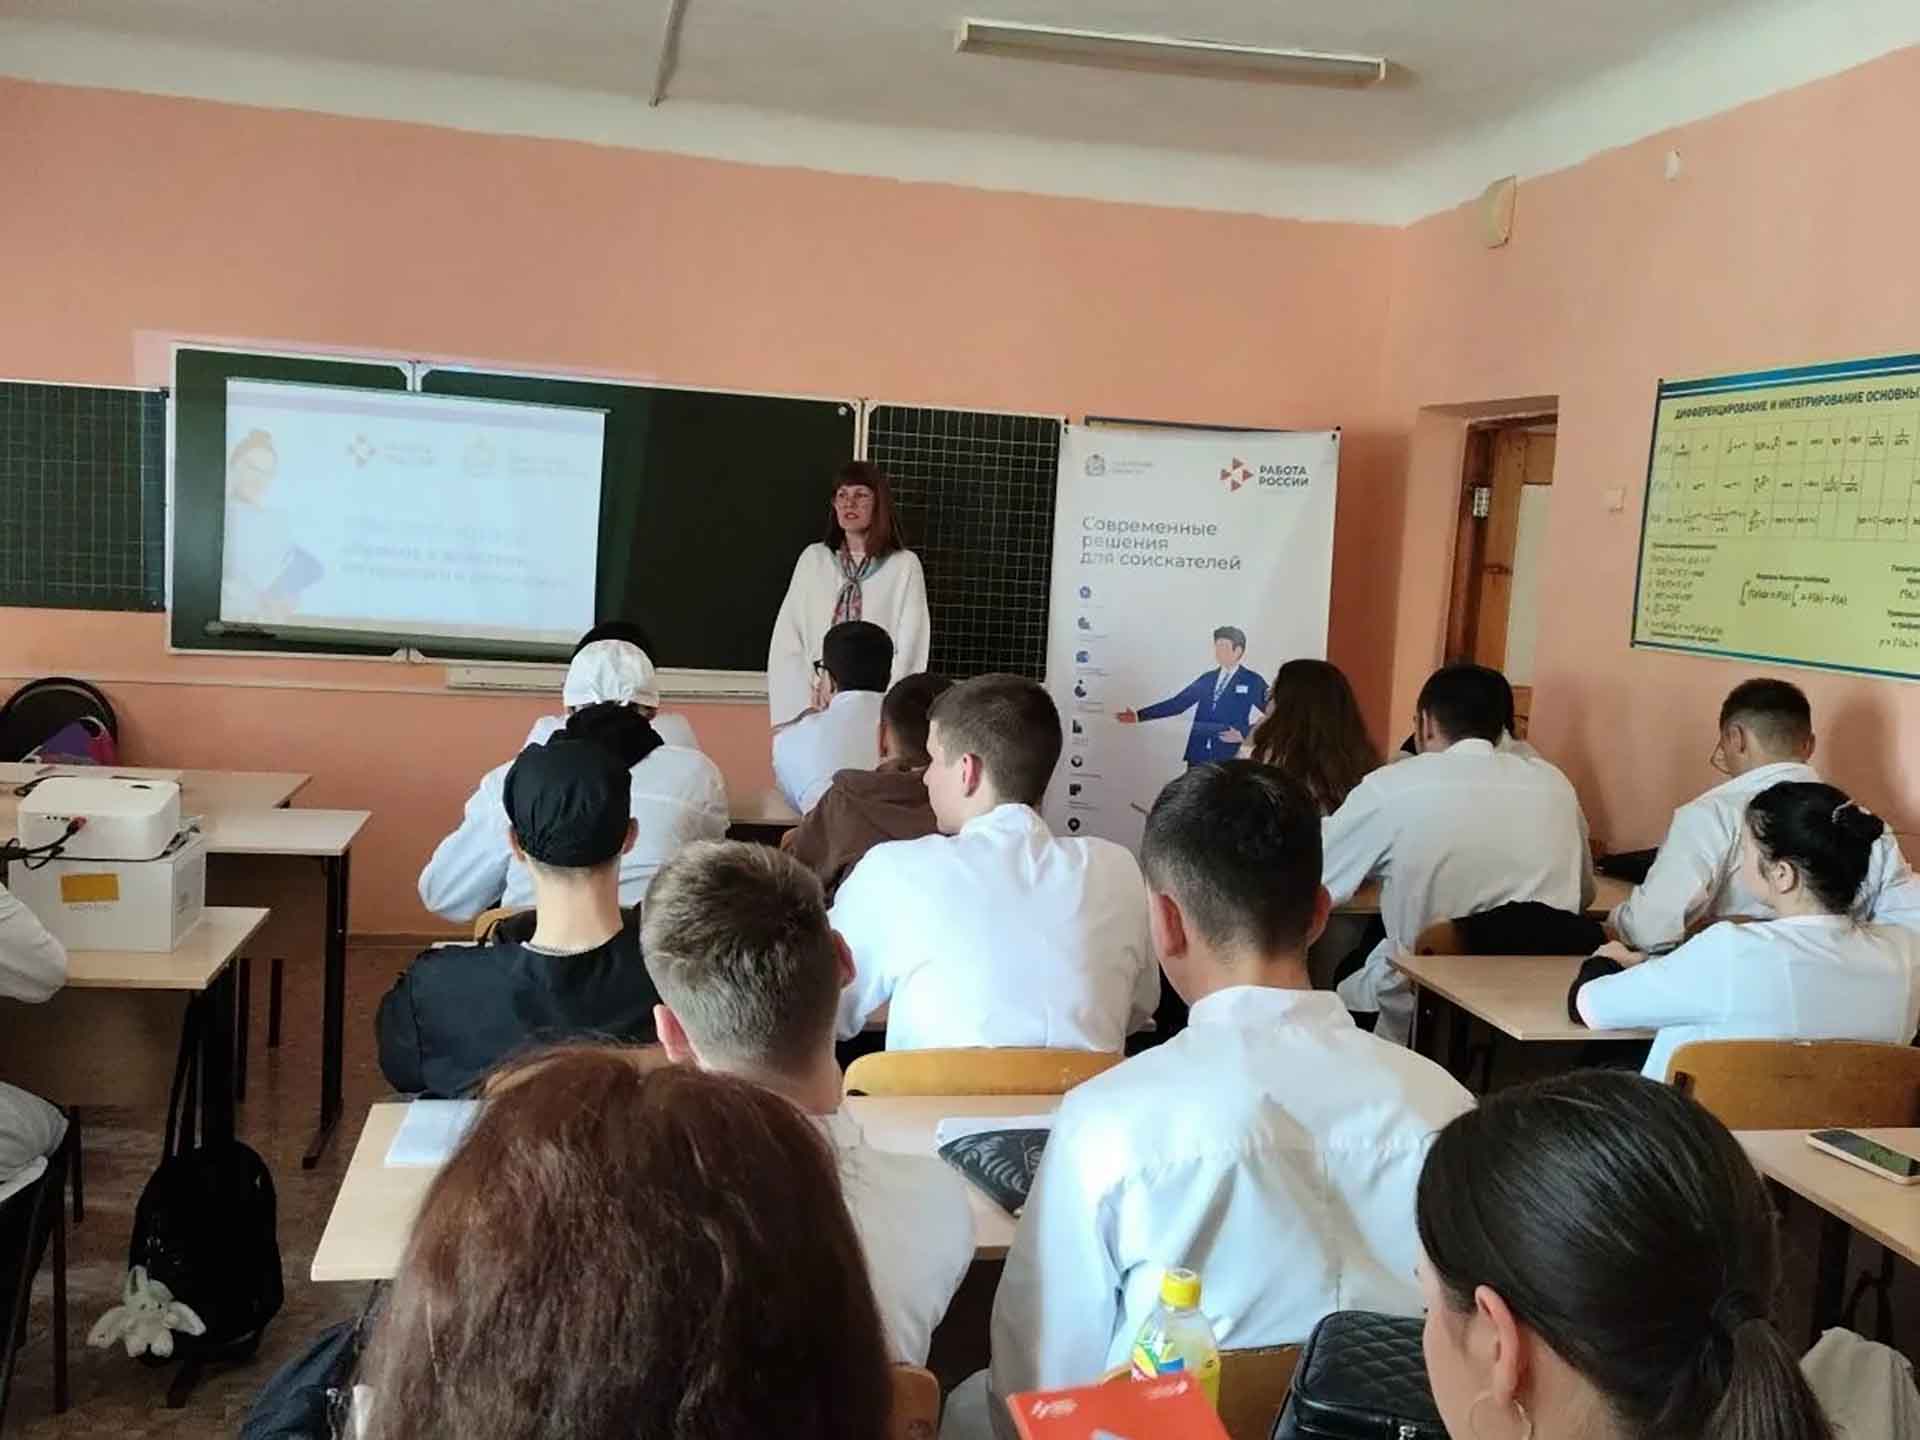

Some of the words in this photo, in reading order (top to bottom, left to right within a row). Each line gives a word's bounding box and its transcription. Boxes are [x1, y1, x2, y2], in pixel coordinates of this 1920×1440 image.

[1778, 391, 1864, 410] ИНТЕГРИРОВАНИЕ
[1258, 464, 1307, 476] РАБОТА
[1258, 476, 1309, 488] РОССИИ
[1082, 515, 1217, 537] Современные
[1081, 535, 1169, 551] решения
[1079, 552, 1114, 566] для
[1119, 553, 1241, 571] соискателей
